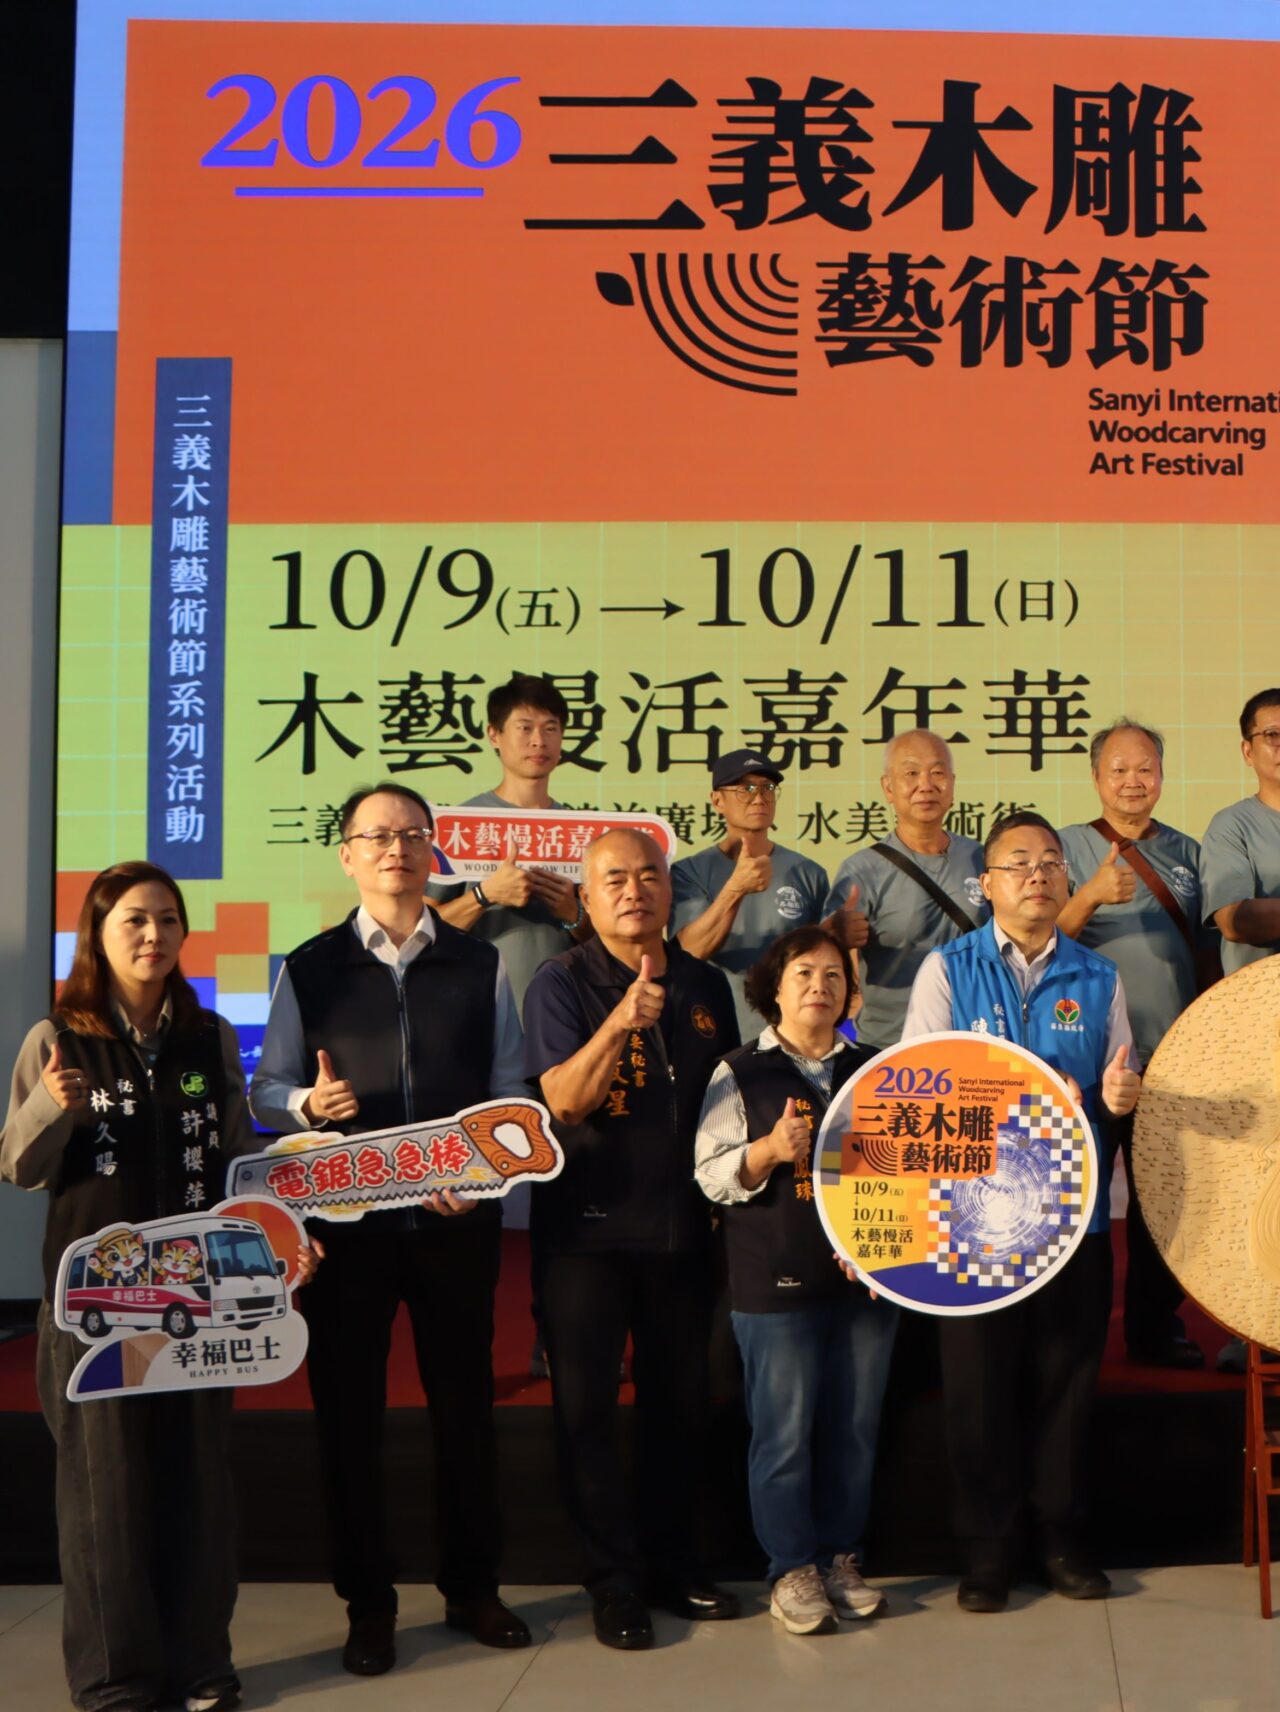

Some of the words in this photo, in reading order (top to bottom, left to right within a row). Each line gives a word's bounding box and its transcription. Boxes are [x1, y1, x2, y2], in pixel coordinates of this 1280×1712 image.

[200, 74, 522, 170] 2026
[523, 76, 1208, 239] 三義木雕
[813, 252, 1210, 372] 藝術節
[1088, 388, 1162, 417] Sanyi
[1089, 420, 1266, 450] Woodcarving
[1089, 451, 1134, 476] Art
[1141, 451, 1244, 477] Festival
[165, 394, 213, 844] 三義木雕藝術節系列活動
[443, 820, 655, 859] 木藝慢活嘉
[464, 863, 498, 872] WOOD
[563, 865, 581, 874] LIF
[875, 1066, 953, 1095] 2026
[958, 1077, 978, 1086] Sanyi
[979, 1078, 1025, 1087] International
[958, 1086, 1005, 1095] Woodcarving
[854, 1102, 995, 1142] 三義木雕
[268, 1132, 473, 1199] 電鋸急急棒
[901, 1142, 993, 1174] 藝術節
[851, 1227, 913, 1243] 木藝慢活
[857, 1243, 903, 1259] 嘉年華
[112, 1290, 157, 1302] 幸福巴士
[171, 1336, 281, 1369] 幸福巴士
[189, 1368, 229, 1378] HAPPY
[237, 1366, 259, 1374] BUS
